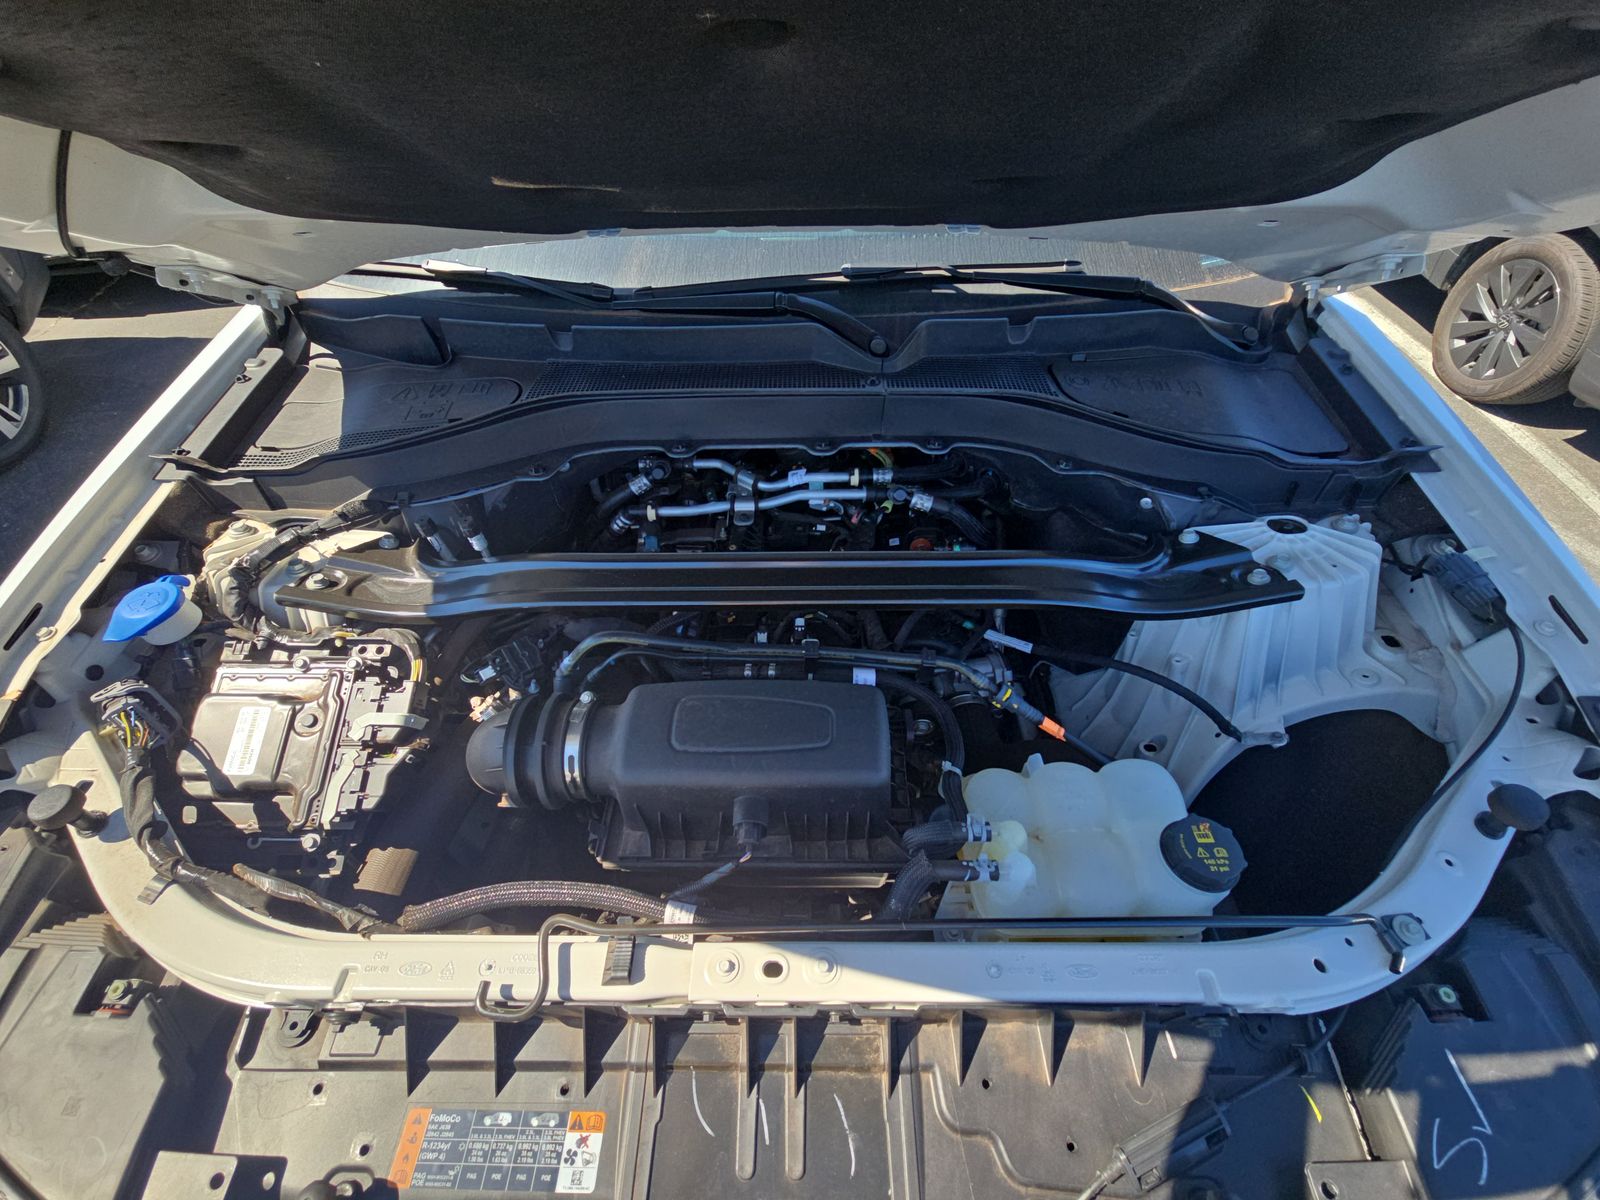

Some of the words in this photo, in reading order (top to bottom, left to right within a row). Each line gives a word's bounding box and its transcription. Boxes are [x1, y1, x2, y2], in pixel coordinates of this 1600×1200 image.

[429, 1114, 461, 1123] FoMoCo
[422, 1142, 451, 1151] R-1234yf
[506, 1143, 513, 1151] kg
[556, 1144, 562, 1152] kg
